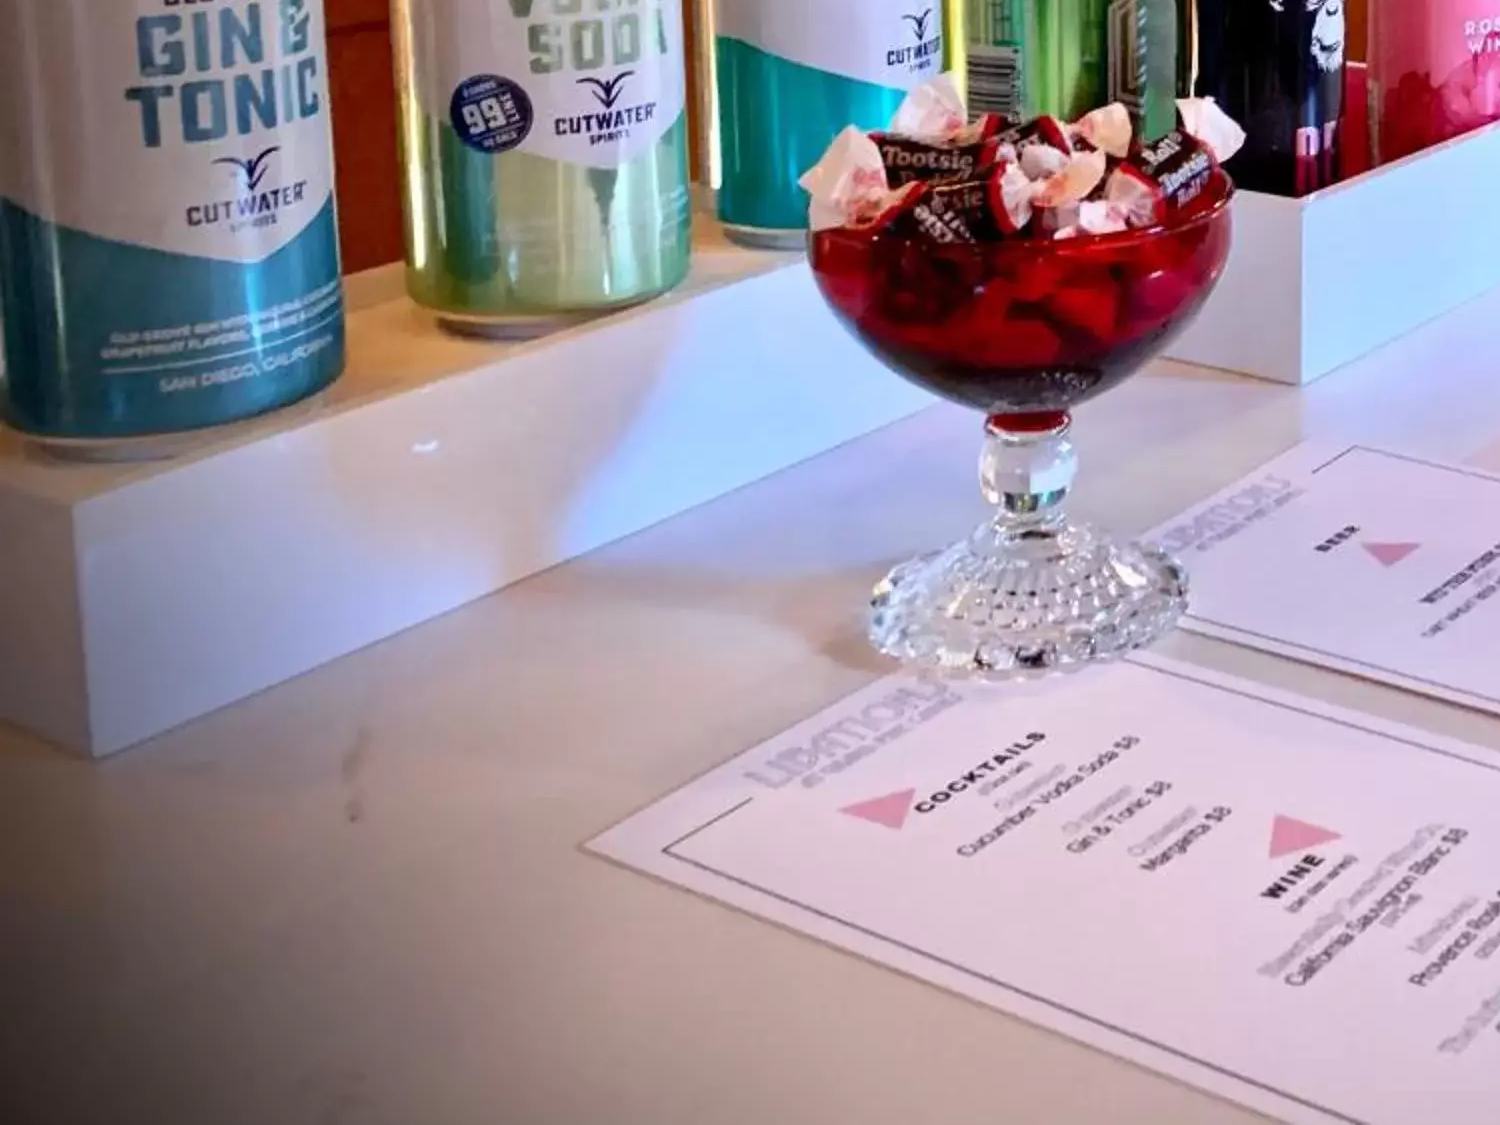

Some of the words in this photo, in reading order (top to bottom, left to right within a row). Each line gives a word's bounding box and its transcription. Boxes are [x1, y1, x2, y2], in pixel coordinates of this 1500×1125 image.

[136, 2, 263, 78] GIN
[124, 56, 319, 148] TONIC
[462, 97, 507, 135] 99
[555, 102, 656, 137] CUTWATER
[883, 146, 974, 170] Tootsie
[186, 181, 307, 227] CUTWATER
[1314, 525, 1360, 553] BEER
[913, 732, 1046, 814] COCKTAILS
[1260, 854, 1326, 899] WINE
[1407, 930, 1478, 988] Provence
